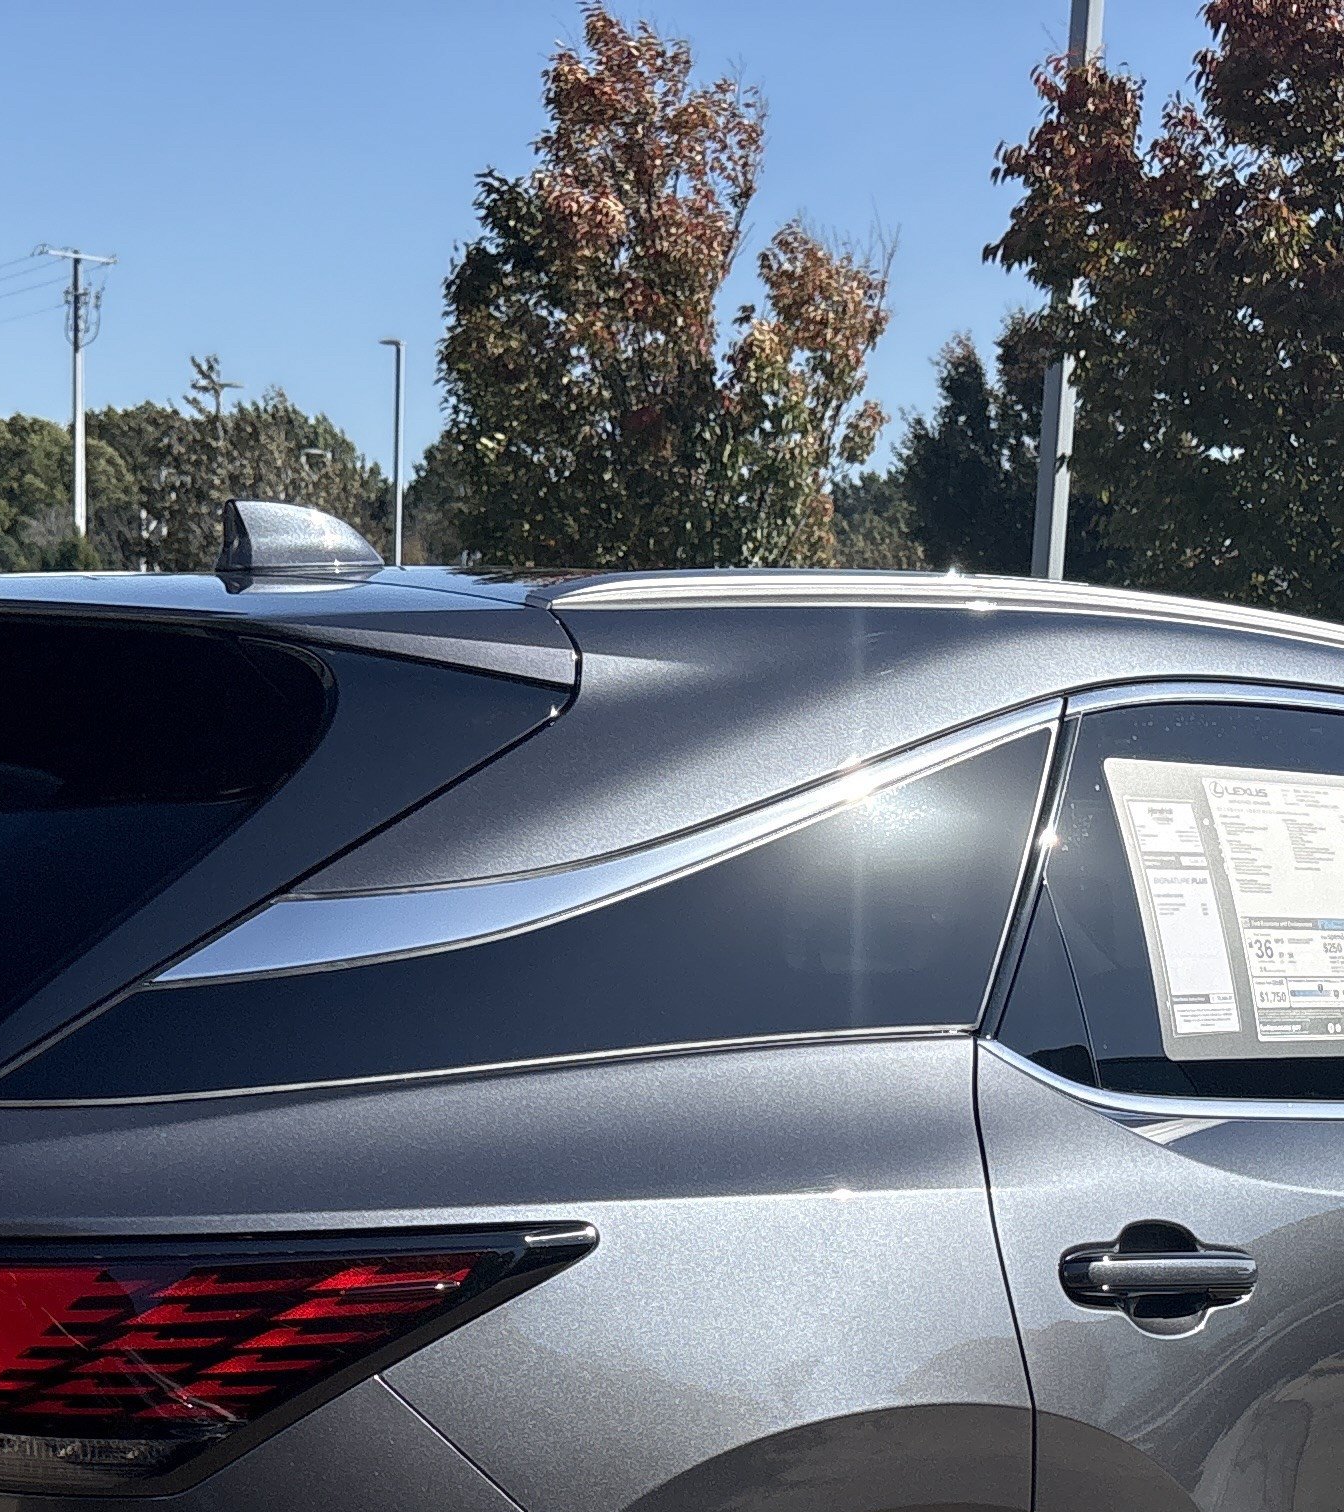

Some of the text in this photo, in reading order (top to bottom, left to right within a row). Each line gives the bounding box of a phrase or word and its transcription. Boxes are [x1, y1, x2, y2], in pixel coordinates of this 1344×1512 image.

[1224, 785, 1268, 798] LEXUS
[1253, 939, 1274, 959] 36
[1259, 991, 1287, 1004] $1,750
